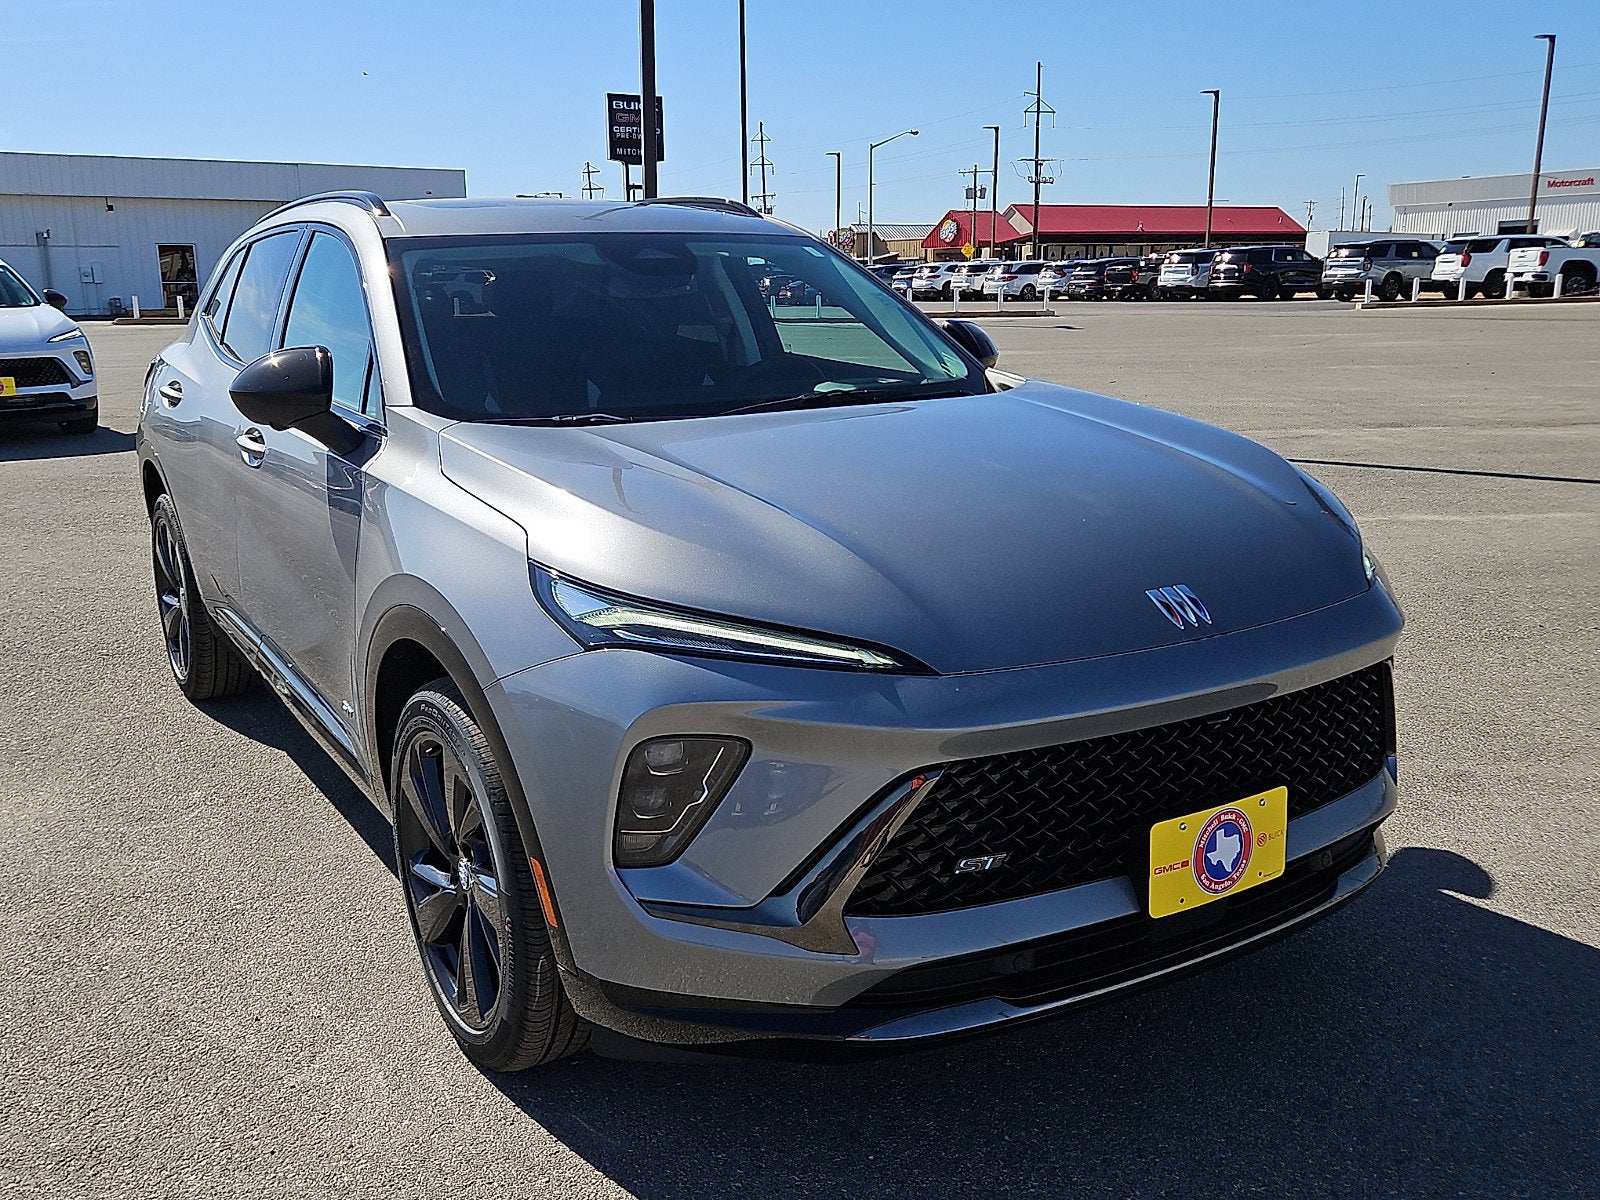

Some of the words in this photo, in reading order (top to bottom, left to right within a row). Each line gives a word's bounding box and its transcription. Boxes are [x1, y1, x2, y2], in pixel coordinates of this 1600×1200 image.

[1547, 177, 1594, 188] Motorcraft
[1199, 818, 1218, 848] Mitchell
[1221, 813, 1236, 821] Buick
[1238, 818, 1248, 833] GMC
[955, 852, 1007, 874] ST
[1153, 861, 1181, 875] GMC
[1200, 873, 1210, 887] San
[1233, 859, 1247, 880] Texas
